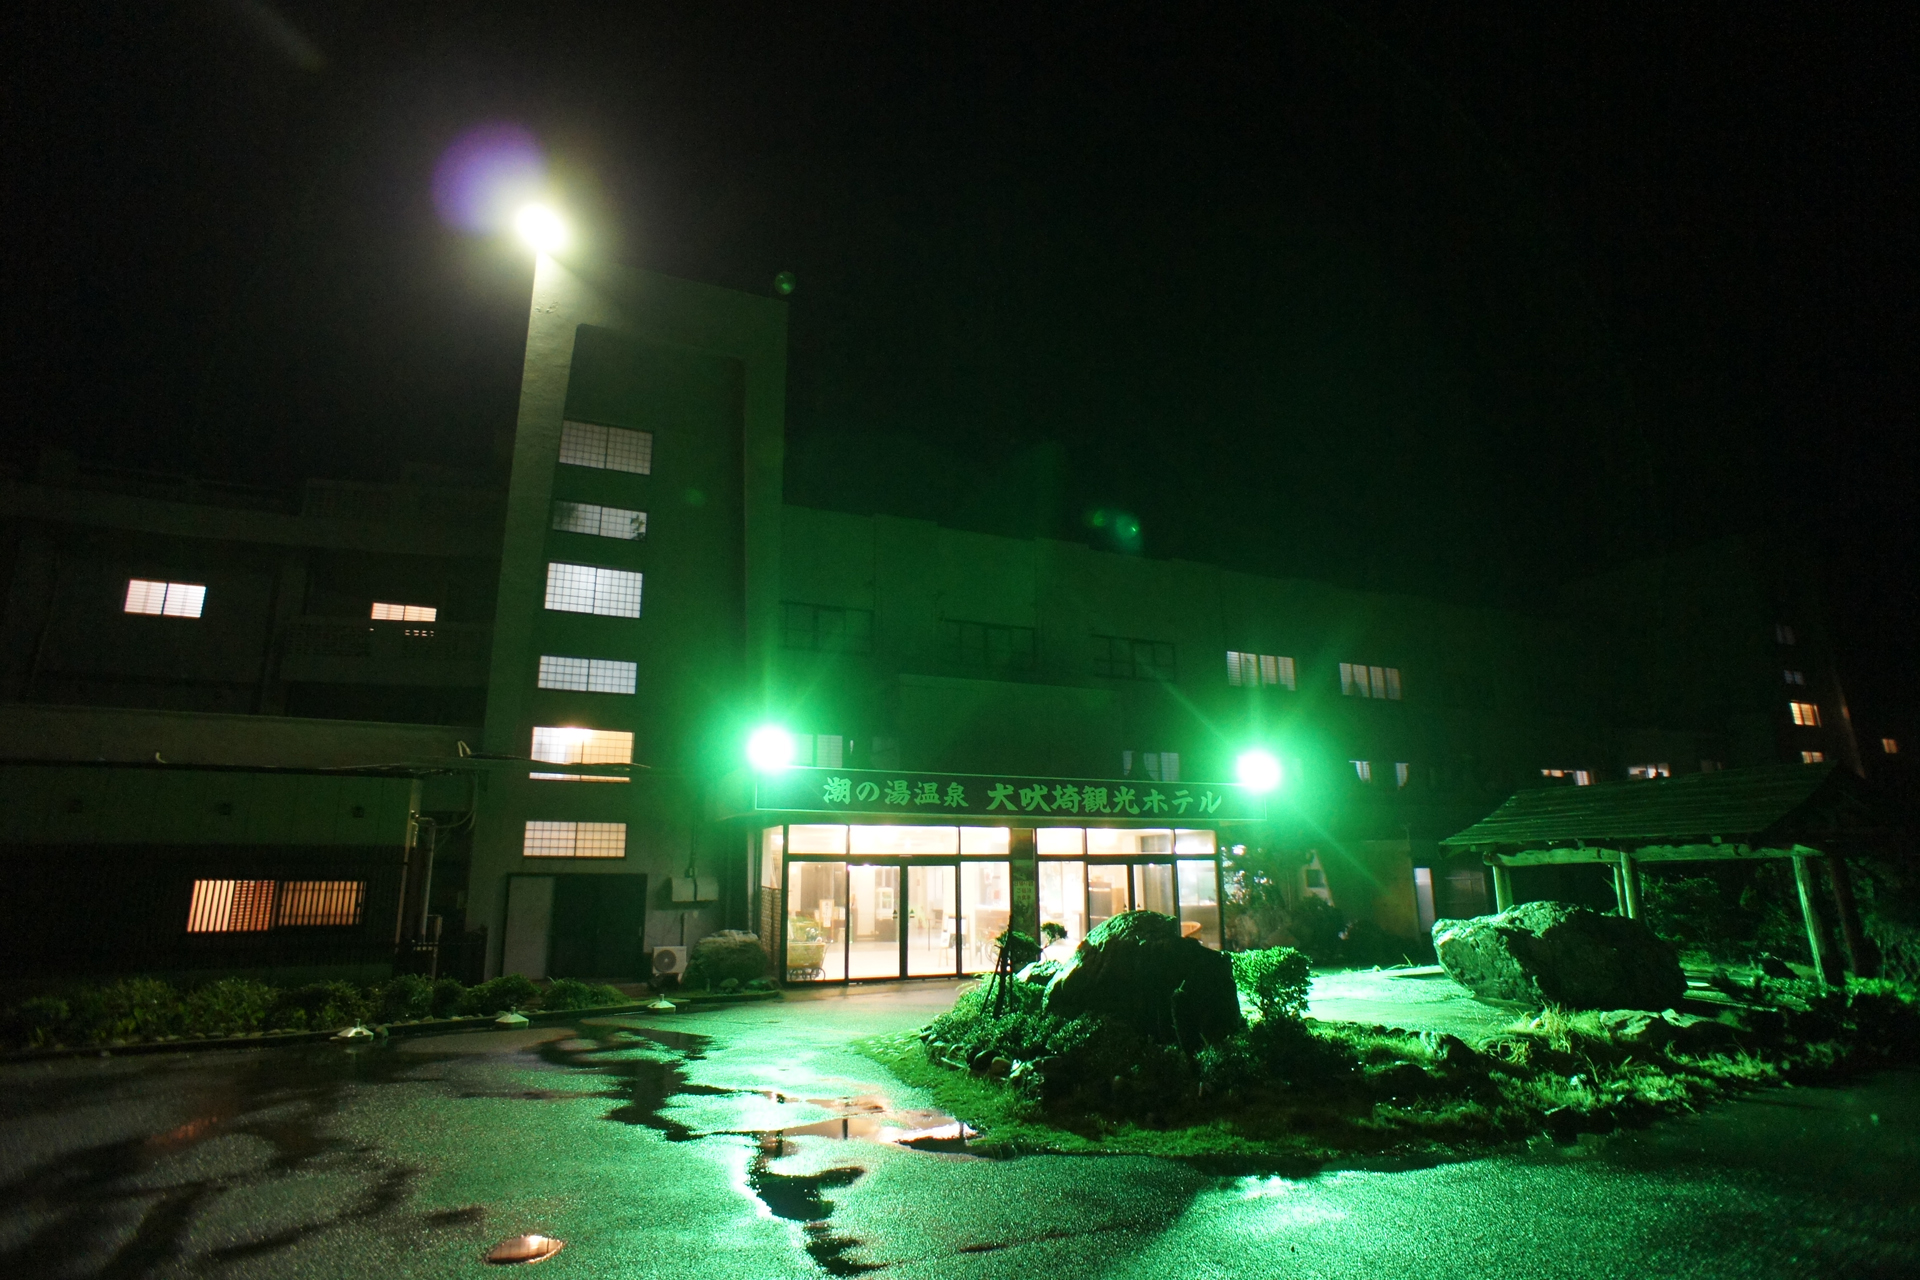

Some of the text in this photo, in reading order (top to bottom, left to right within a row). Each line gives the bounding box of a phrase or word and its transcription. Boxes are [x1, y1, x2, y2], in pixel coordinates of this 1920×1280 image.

[823, 776, 969, 807] 潮の湯温泉
